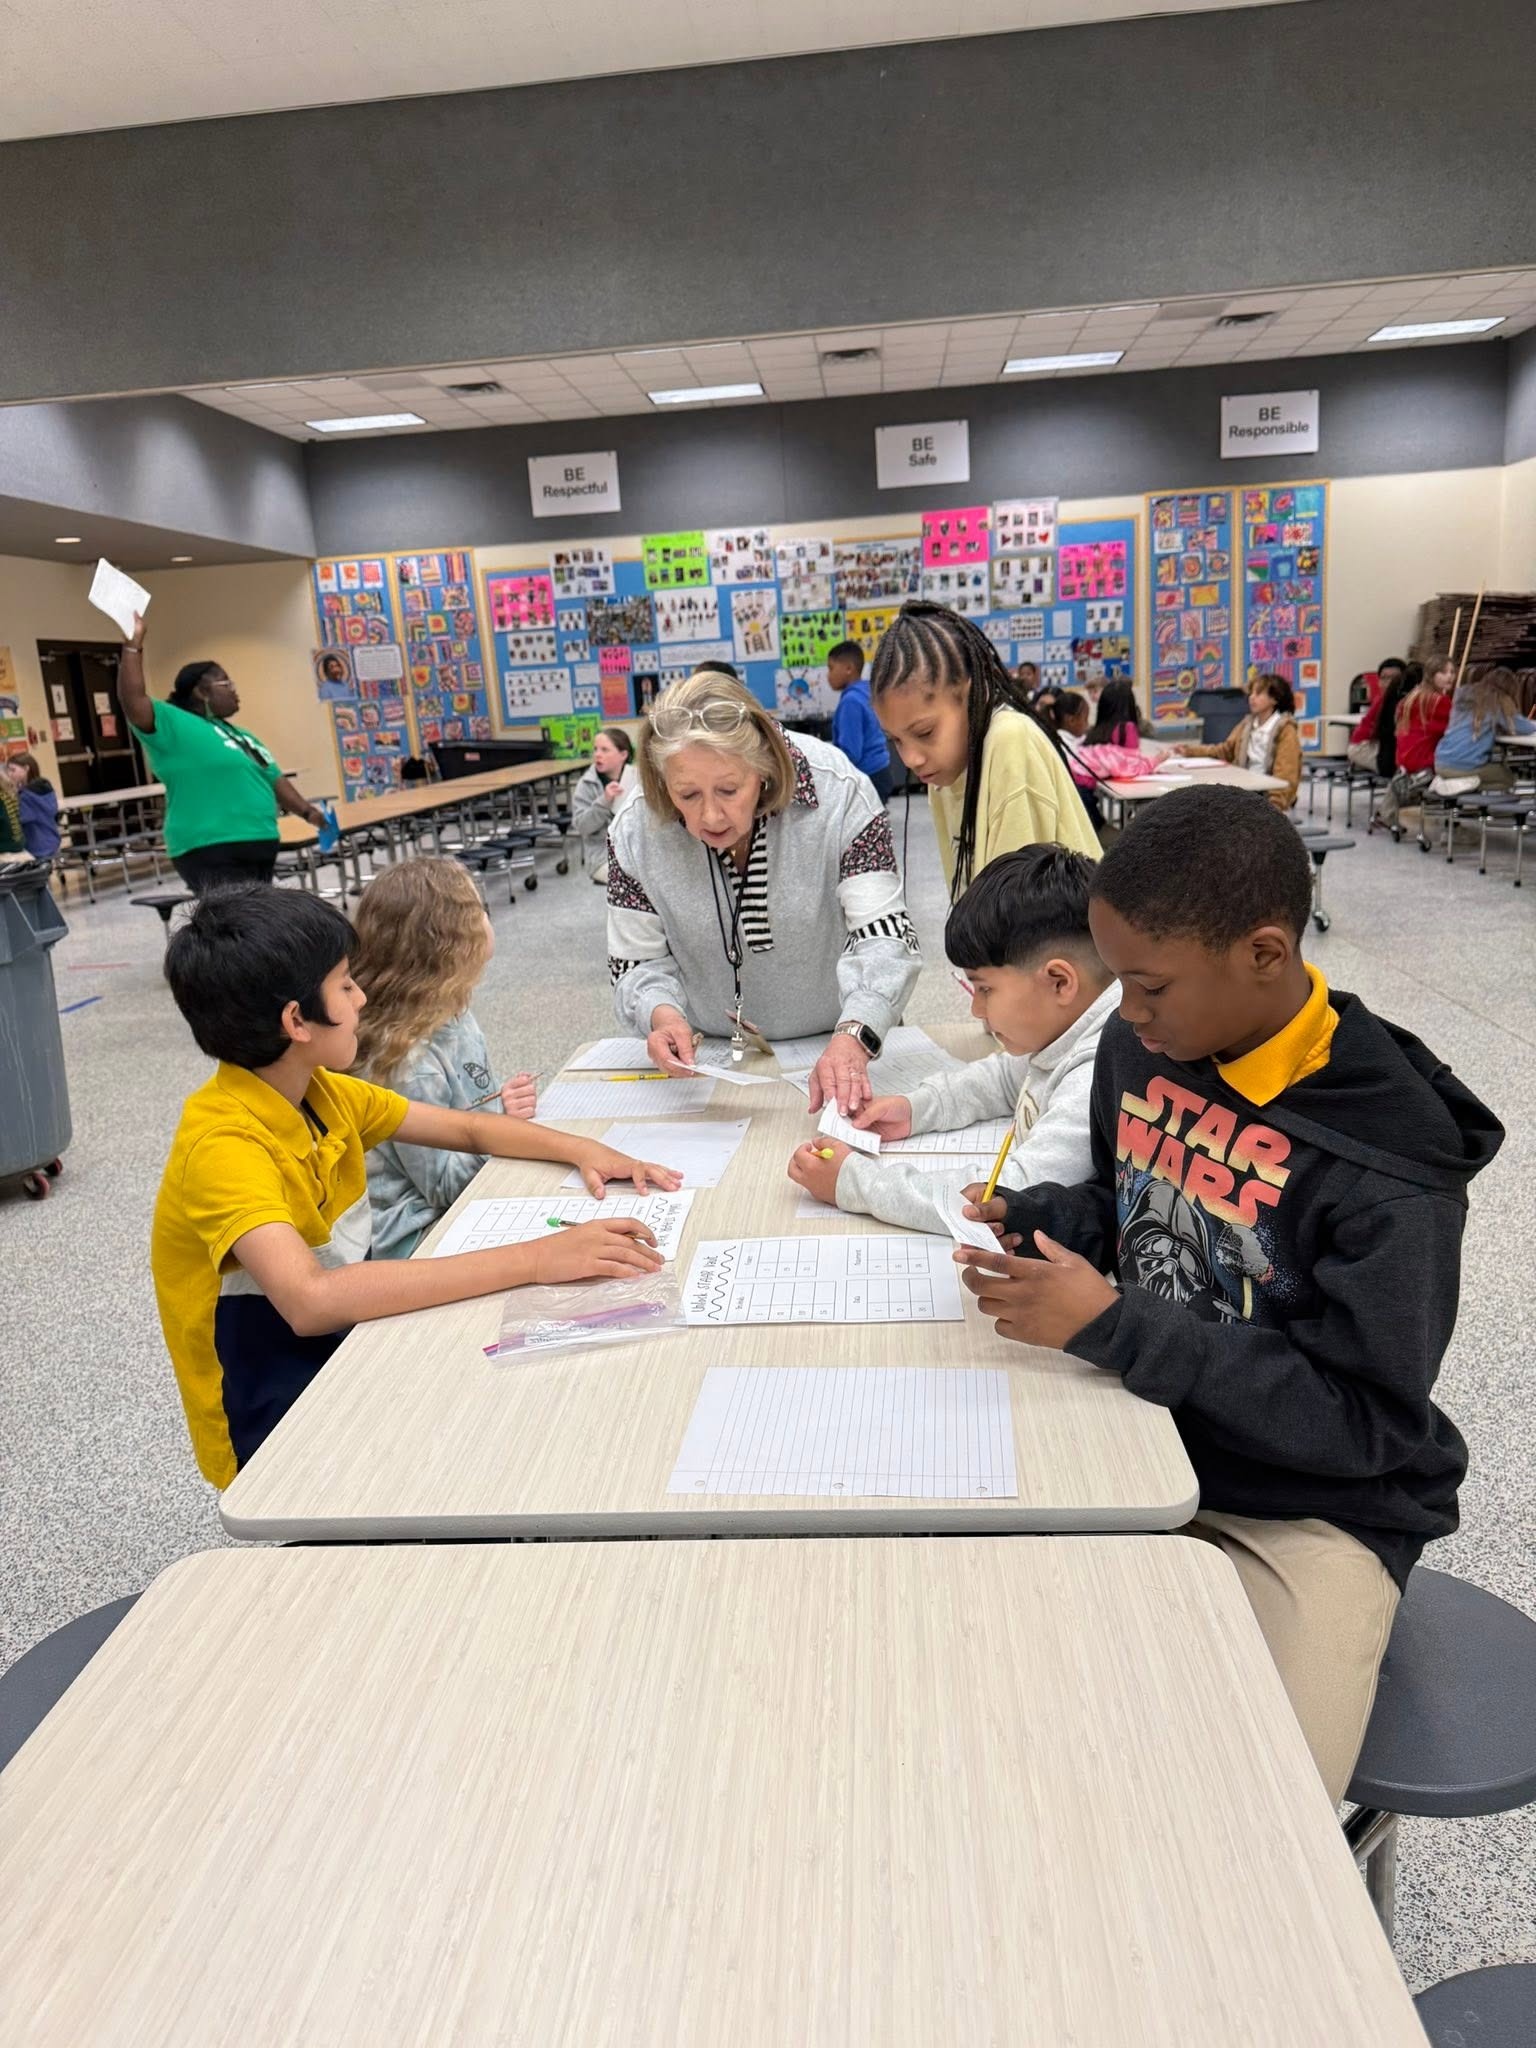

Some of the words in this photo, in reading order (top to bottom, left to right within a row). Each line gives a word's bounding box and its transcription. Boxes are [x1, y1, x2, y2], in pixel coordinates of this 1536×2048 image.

[1258, 406, 1281, 421] BE
[1229, 421, 1310, 440] Responsible
[912, 436, 934, 452] BE
[908, 453, 937, 467] Safe
[564, 467, 585, 482] BE
[543, 481, 608, 499] Respectful
[1120, 1075, 1291, 1188] STAR
[1117, 1110, 1282, 1228] WARS
[697, 1270, 716, 1290] STAAR
